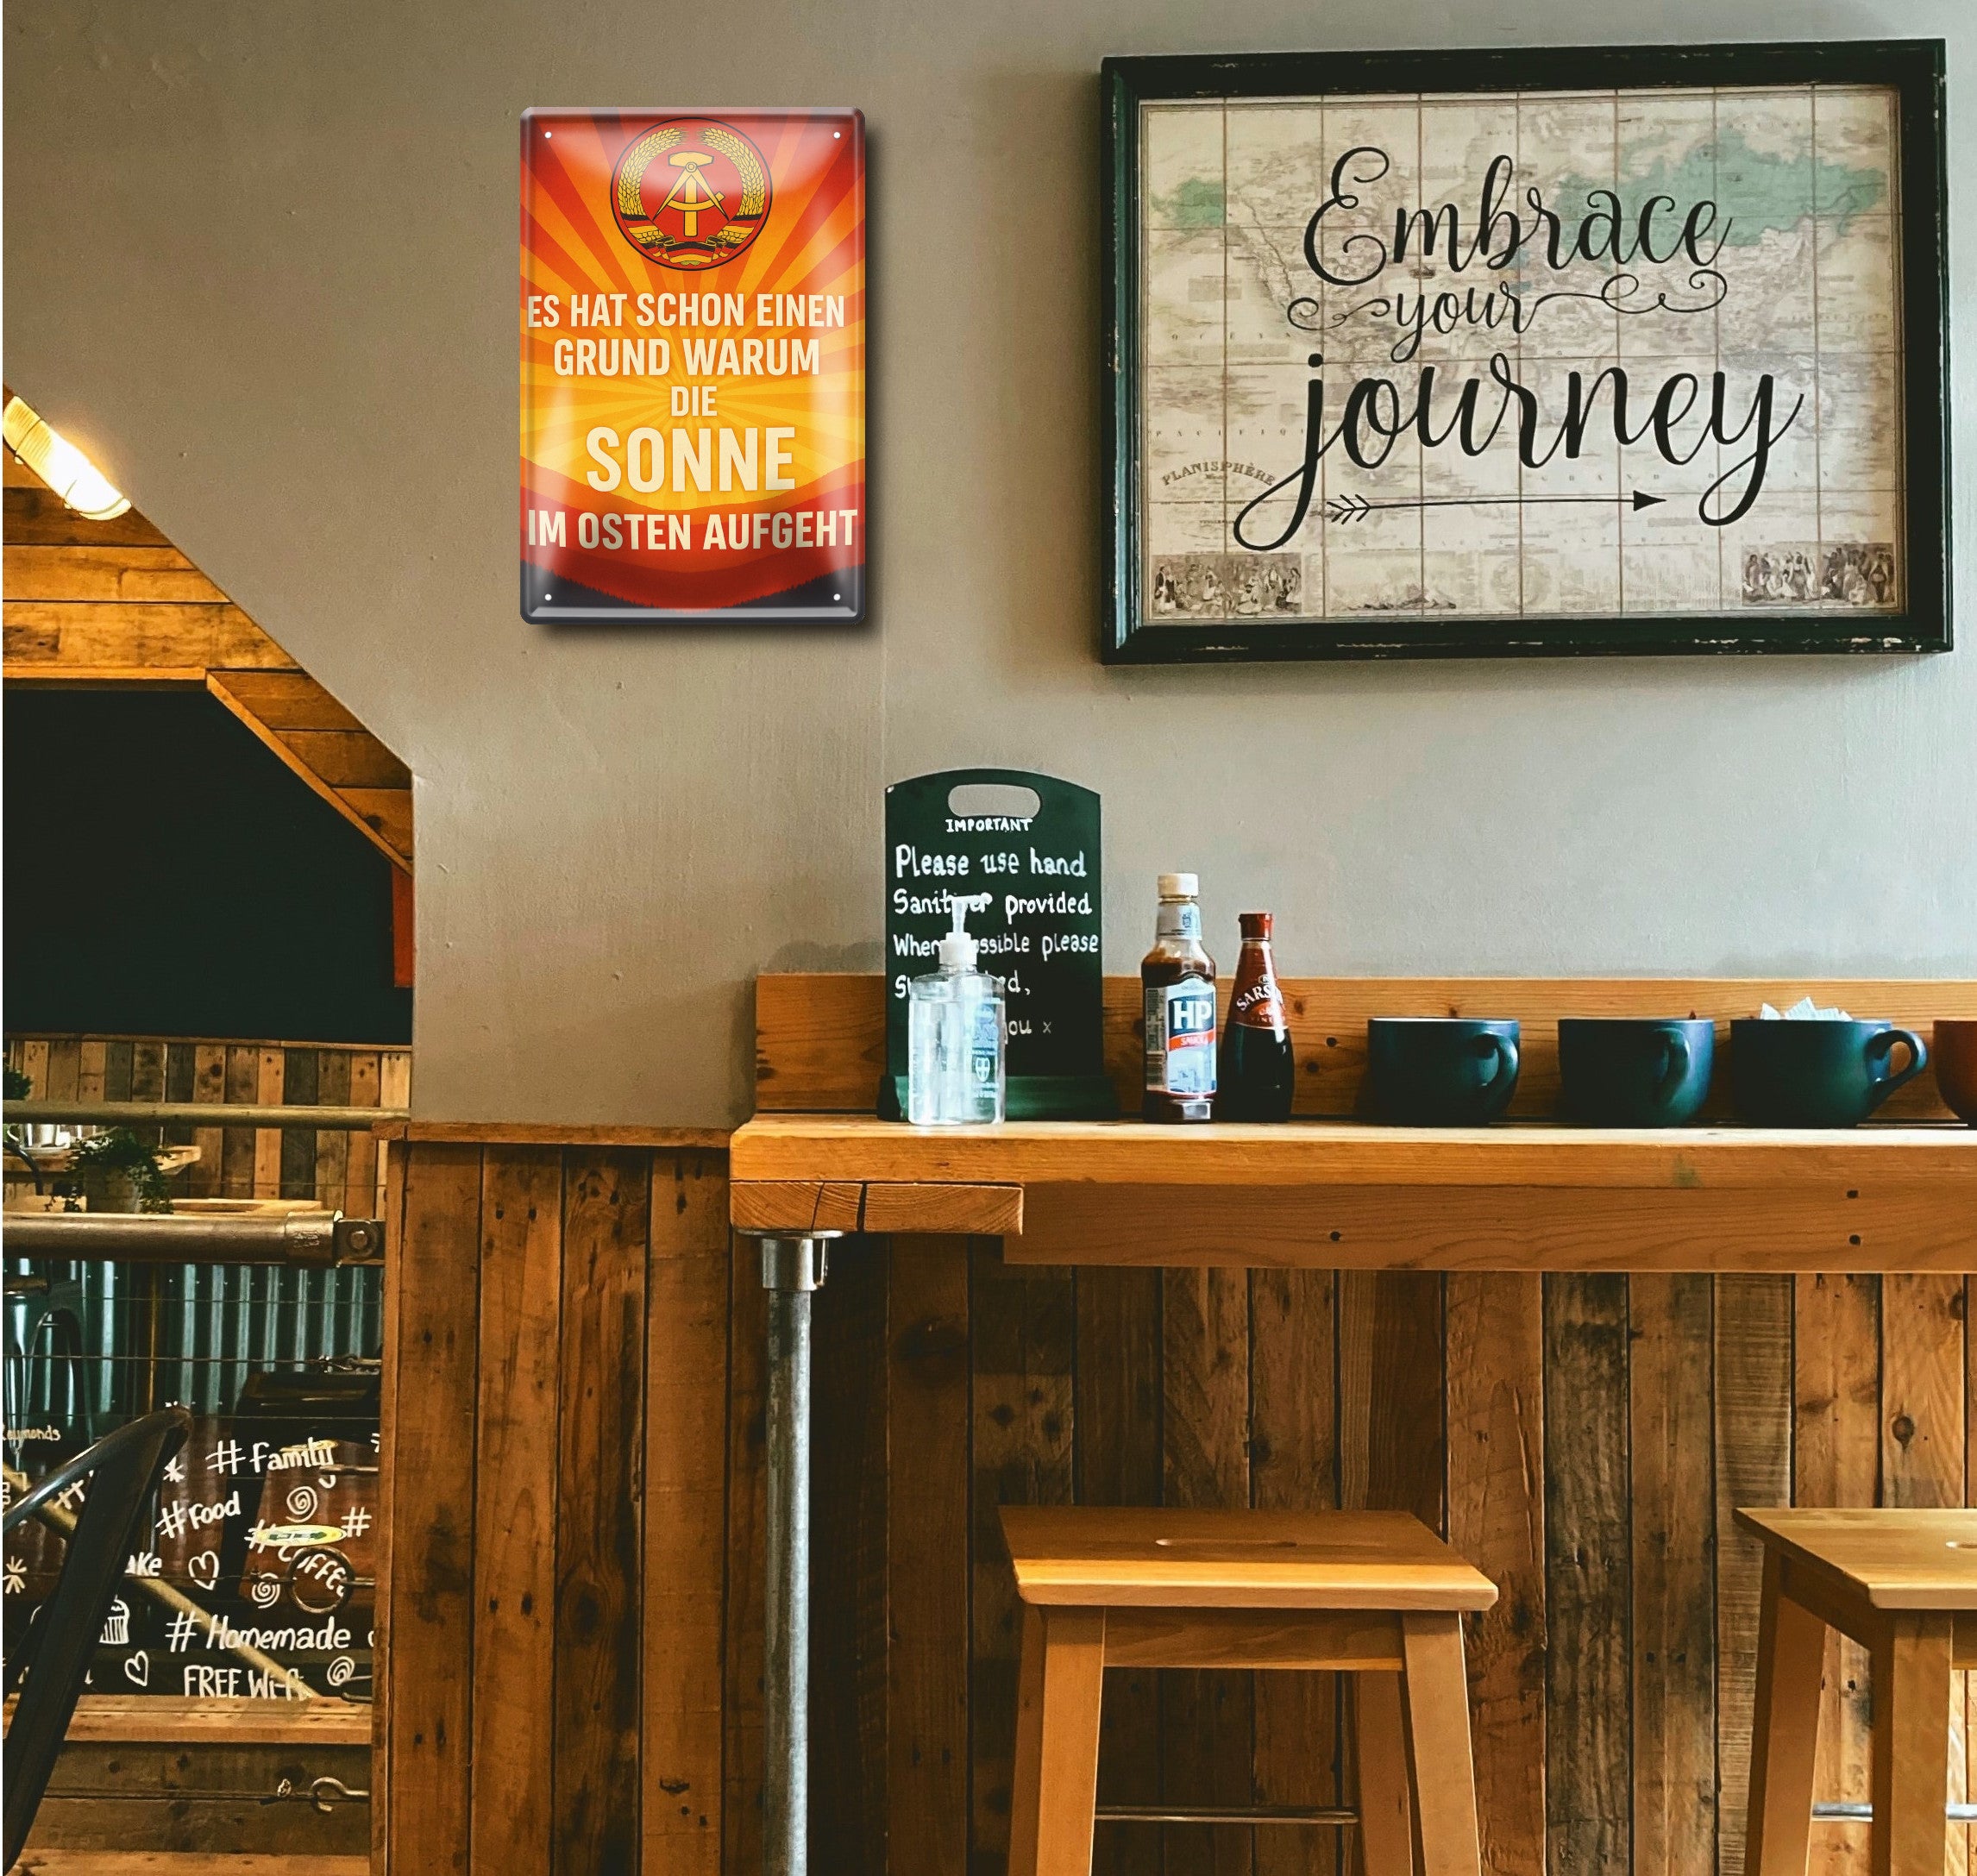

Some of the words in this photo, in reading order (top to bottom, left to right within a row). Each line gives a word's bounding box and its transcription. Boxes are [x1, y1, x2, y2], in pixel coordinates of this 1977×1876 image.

[1303, 147, 1731, 285] Embrace
[527, 295, 560, 328] ES
[571, 293, 627, 327] HAT
[636, 292, 744, 327] SCHON
[756, 294, 844, 328] EINEN
[553, 338, 671, 376] GRUND
[683, 338, 819, 375] WARUM
[670, 386, 717, 417] DIE
[586, 426, 795, 493] SONNE
[1233, 354, 1804, 551] journey
[1161, 461, 1276, 486] PLANISPHÈRE
[528, 509, 567, 548] IM
[578, 511, 691, 550] OSTEN
[702, 509, 857, 550] AUFGEHT
[945, 818, 1032, 832] IMPORTANT
[895, 844, 970, 878] Please
[980, 852, 1020, 875] use
[1030, 847, 1087, 878] hand
[894, 888, 986, 914] Saniter
[1005, 891, 1093, 925] provided
[975, 932, 1030, 954] ssible
[1042, 933, 1099, 962] please
[1173, 1001, 1212, 1030] HP
[184, 1666, 242, 1698] FREE
